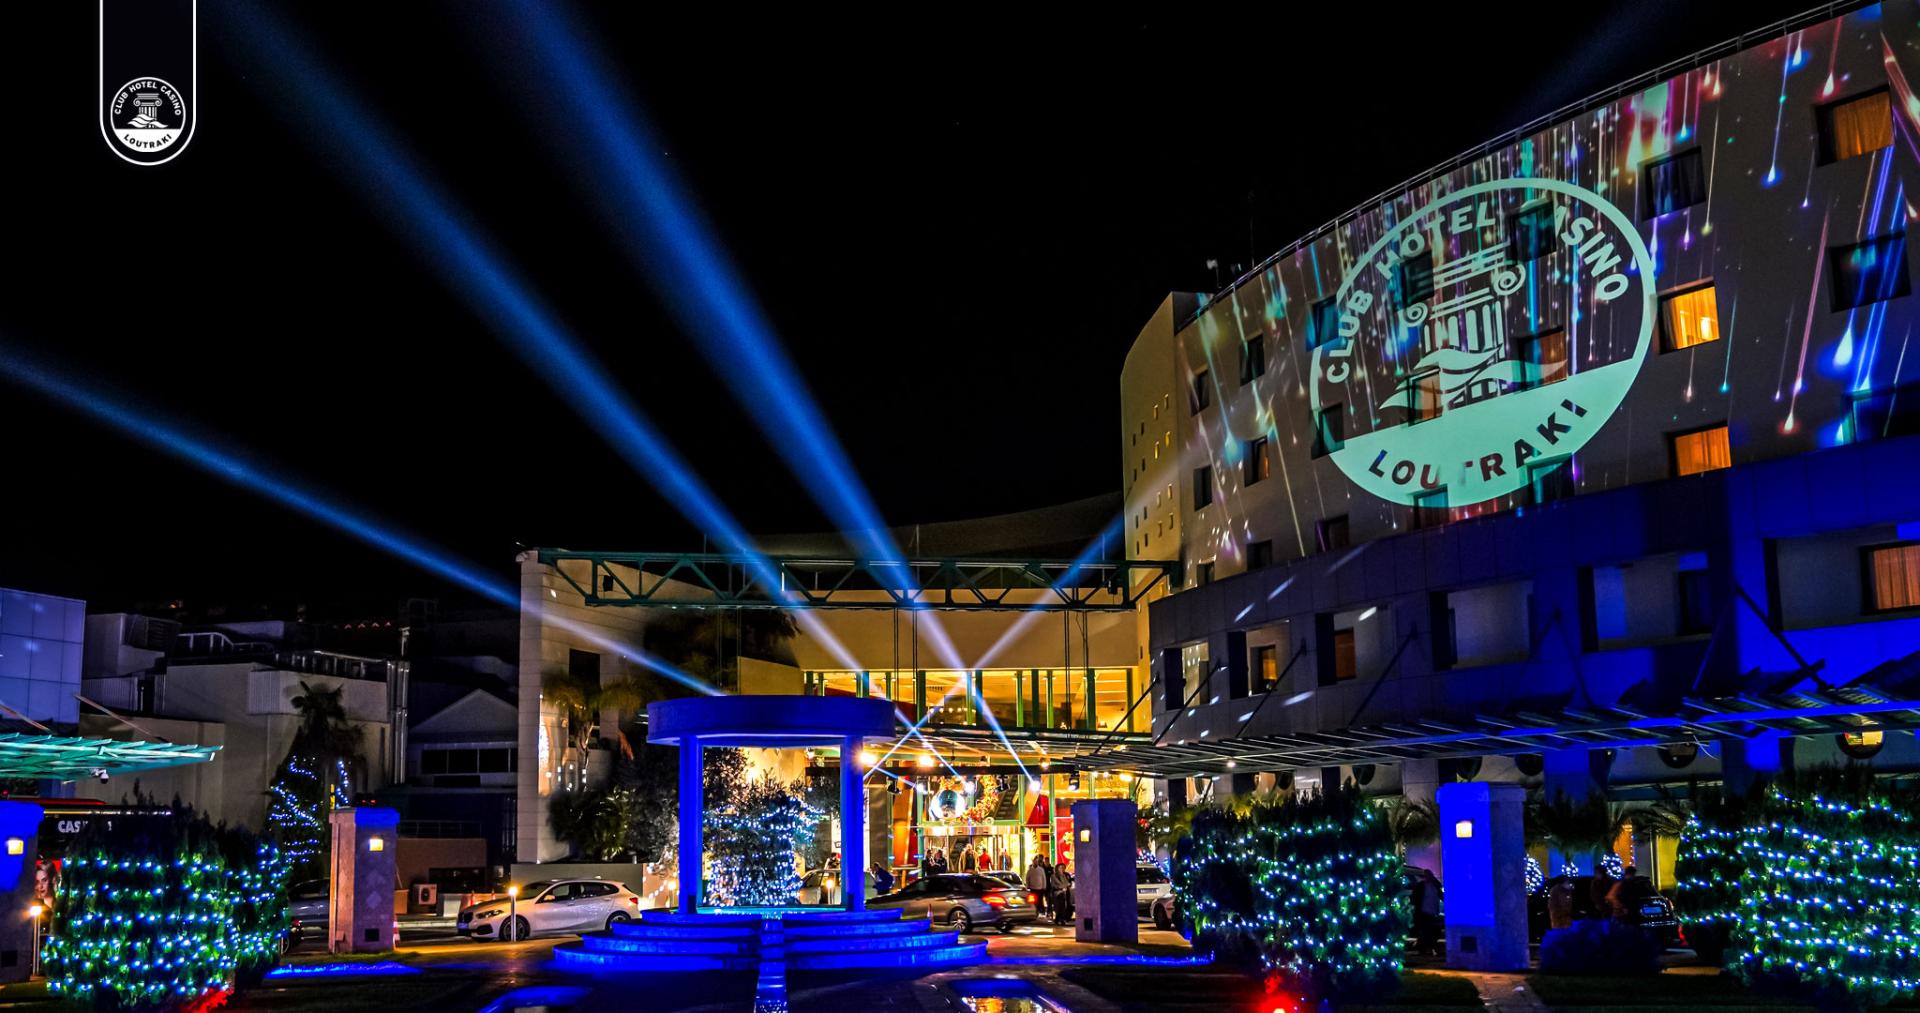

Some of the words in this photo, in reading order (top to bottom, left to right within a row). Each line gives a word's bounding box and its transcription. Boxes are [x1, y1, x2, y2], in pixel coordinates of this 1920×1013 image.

[1326, 289, 1374, 384] CLUB
[1375, 202, 1496, 281] HOTEL
[1522, 204, 1629, 302] SINO
[1368, 398, 1588, 490] LOURAKI
